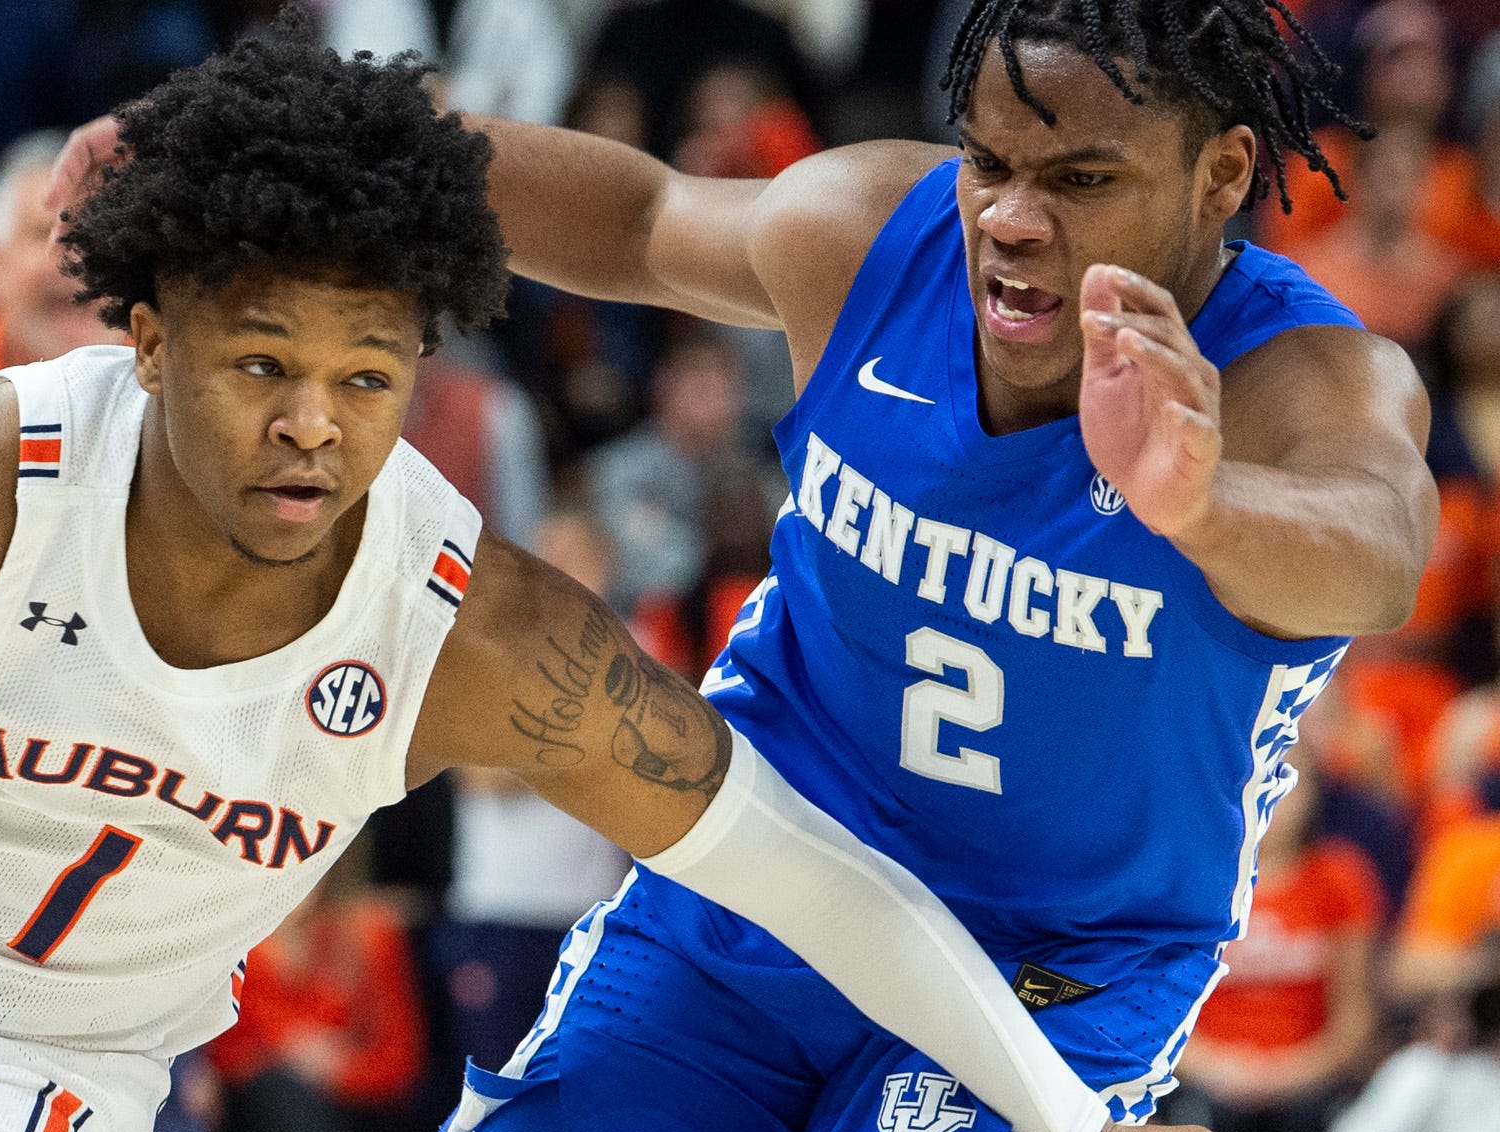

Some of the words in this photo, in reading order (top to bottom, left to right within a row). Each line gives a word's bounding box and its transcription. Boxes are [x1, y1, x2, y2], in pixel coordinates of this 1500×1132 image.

[797, 431, 1163, 659] KENTUCKY
[310, 665, 382, 737] SEC
[509, 635, 598, 768] Hold
[900, 625, 1004, 795] 2
[7, 823, 144, 964] 1
